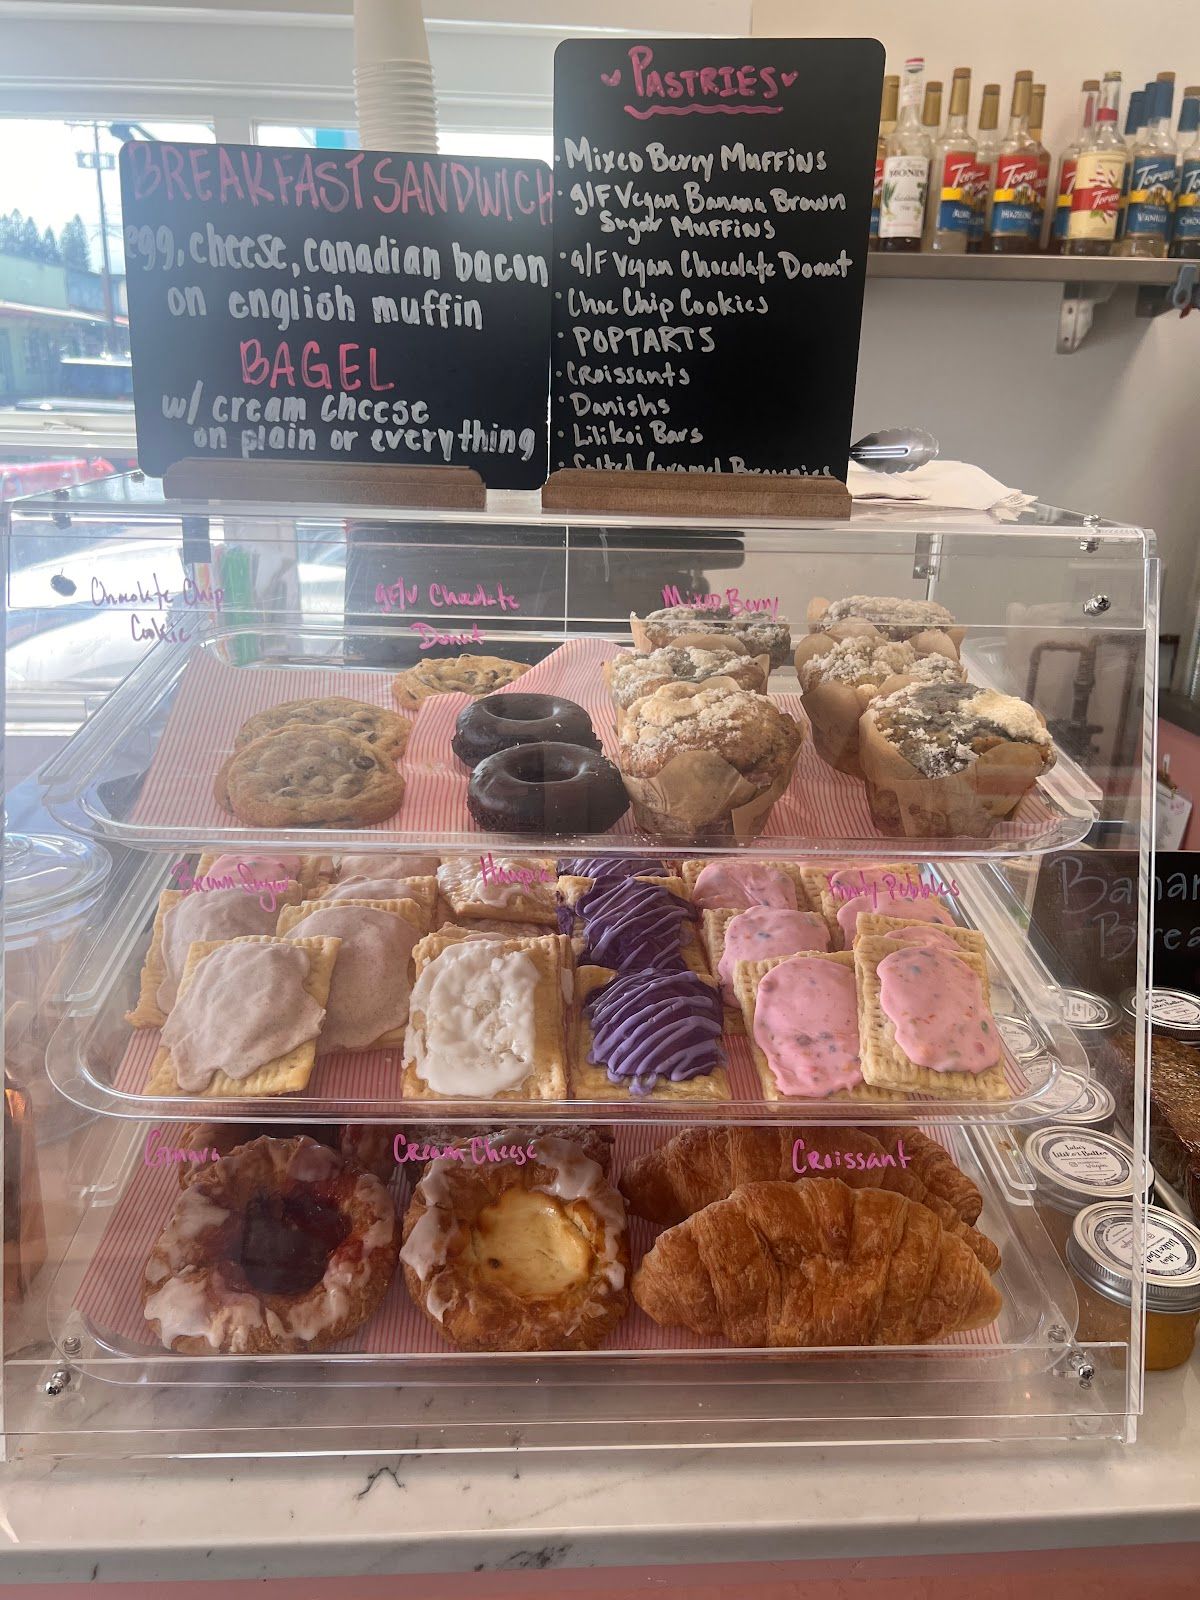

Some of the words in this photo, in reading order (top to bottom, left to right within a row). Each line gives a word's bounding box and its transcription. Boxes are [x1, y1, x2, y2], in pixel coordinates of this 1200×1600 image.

[646, 142, 714, 182] Berry
[128, 141, 365, 212] BREAKFAST
[373, 156, 552, 226] SANDWICH
[614, 181, 679, 219] Vegan
[683, 182, 767, 213] Banana
[770, 188, 846, 213] Brown
[599, 211, 663, 246] Sugar
[304, 236, 440, 279] canadian
[452, 243, 549, 288] bacon
[613, 252, 674, 288] Vegan
[778, 250, 853, 280] Donut
[167, 285, 207, 317] on
[228, 285, 355, 330] english
[372, 289, 483, 330] muffin
[568, 288, 619, 317] Choc
[622, 287, 674, 322] Chip
[681, 288, 769, 317] Cookies
[572, 326, 716, 357] POPTARTS
[239, 338, 396, 391] BAGEL
[161, 381, 203, 424] w/
[212, 395, 306, 423] cream
[569, 392, 671, 417] Danishs
[193, 427, 228, 449] on
[241, 424, 316, 459] plain
[330, 428, 359, 451] or
[371, 419, 536, 462] everything
[573, 420, 644, 447] Lilikoi
[649, 420, 703, 445] Bars
[183, 577, 225, 611] Chip
[726, 588, 778, 623] Berry
[410, 622, 485, 650] Donut
[471, 1137, 538, 1166] Cheese
